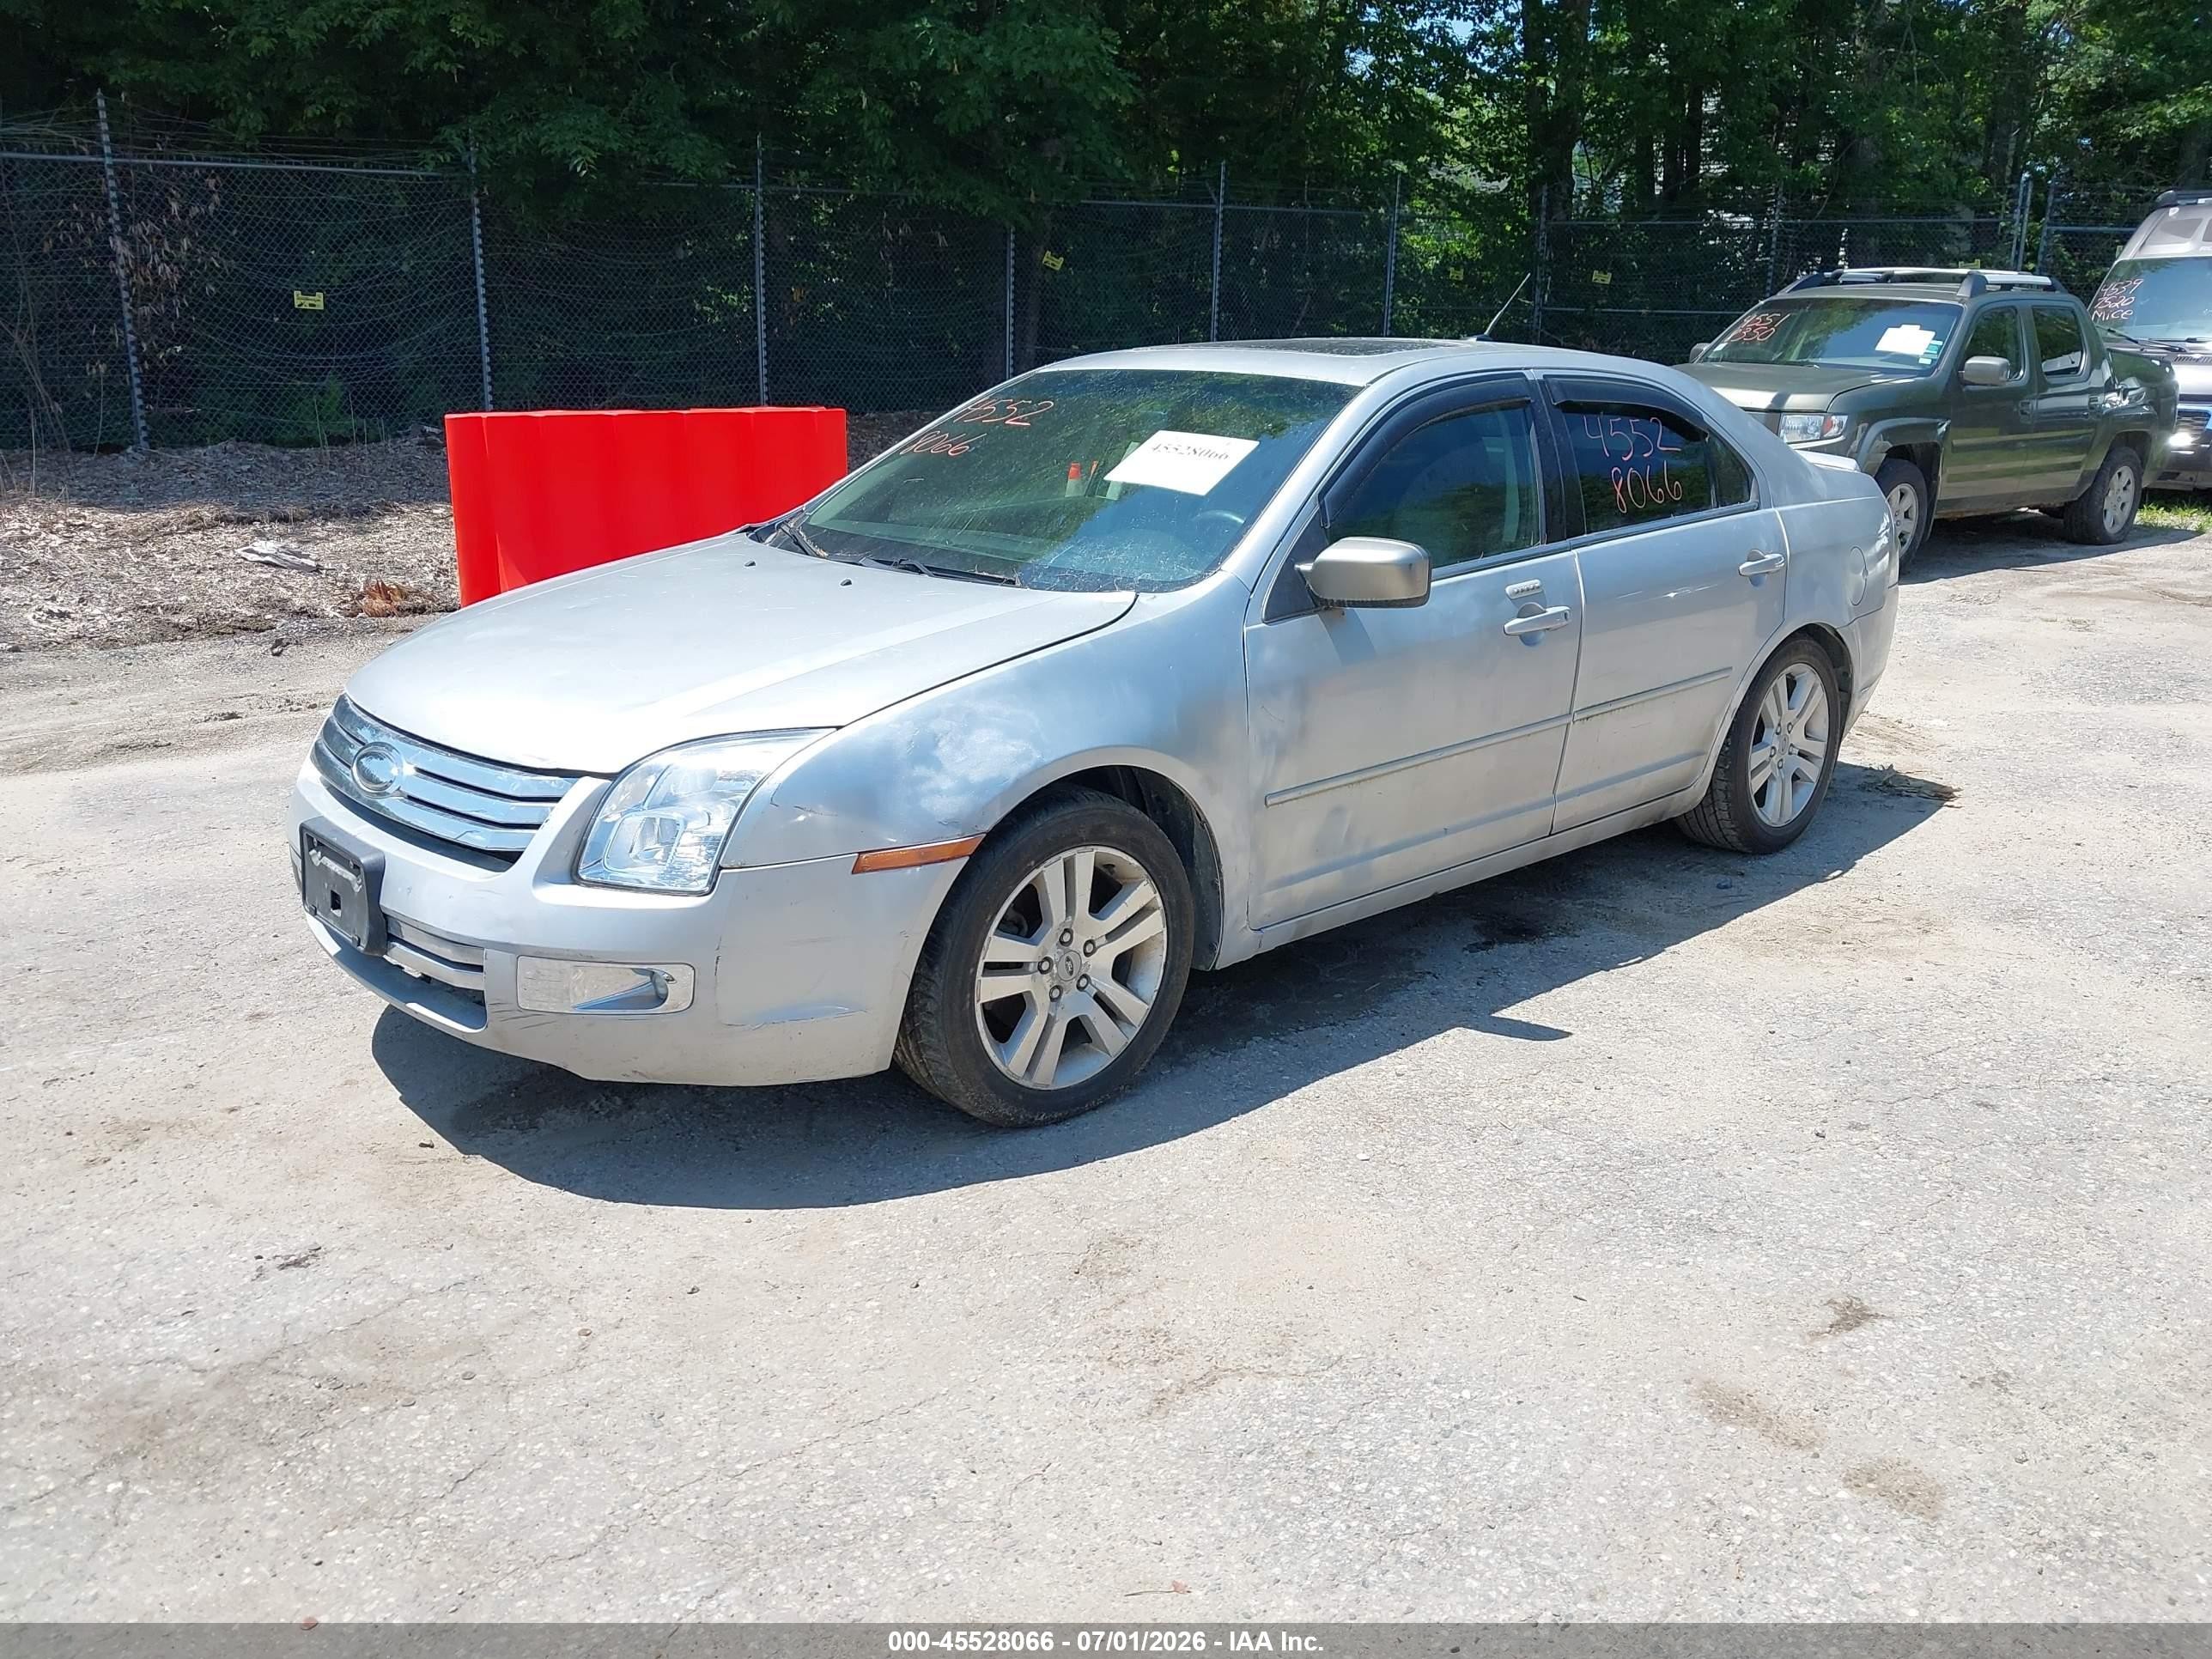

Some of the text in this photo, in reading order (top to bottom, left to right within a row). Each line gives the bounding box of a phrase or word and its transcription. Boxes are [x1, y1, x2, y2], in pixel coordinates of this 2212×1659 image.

[2100, 278, 2144, 297] 4539
[953, 397, 1054, 426] 4552
[899, 430, 988, 457] 8066
[1583, 414, 1682, 461] 4552
[1610, 459, 1683, 514] 8066
